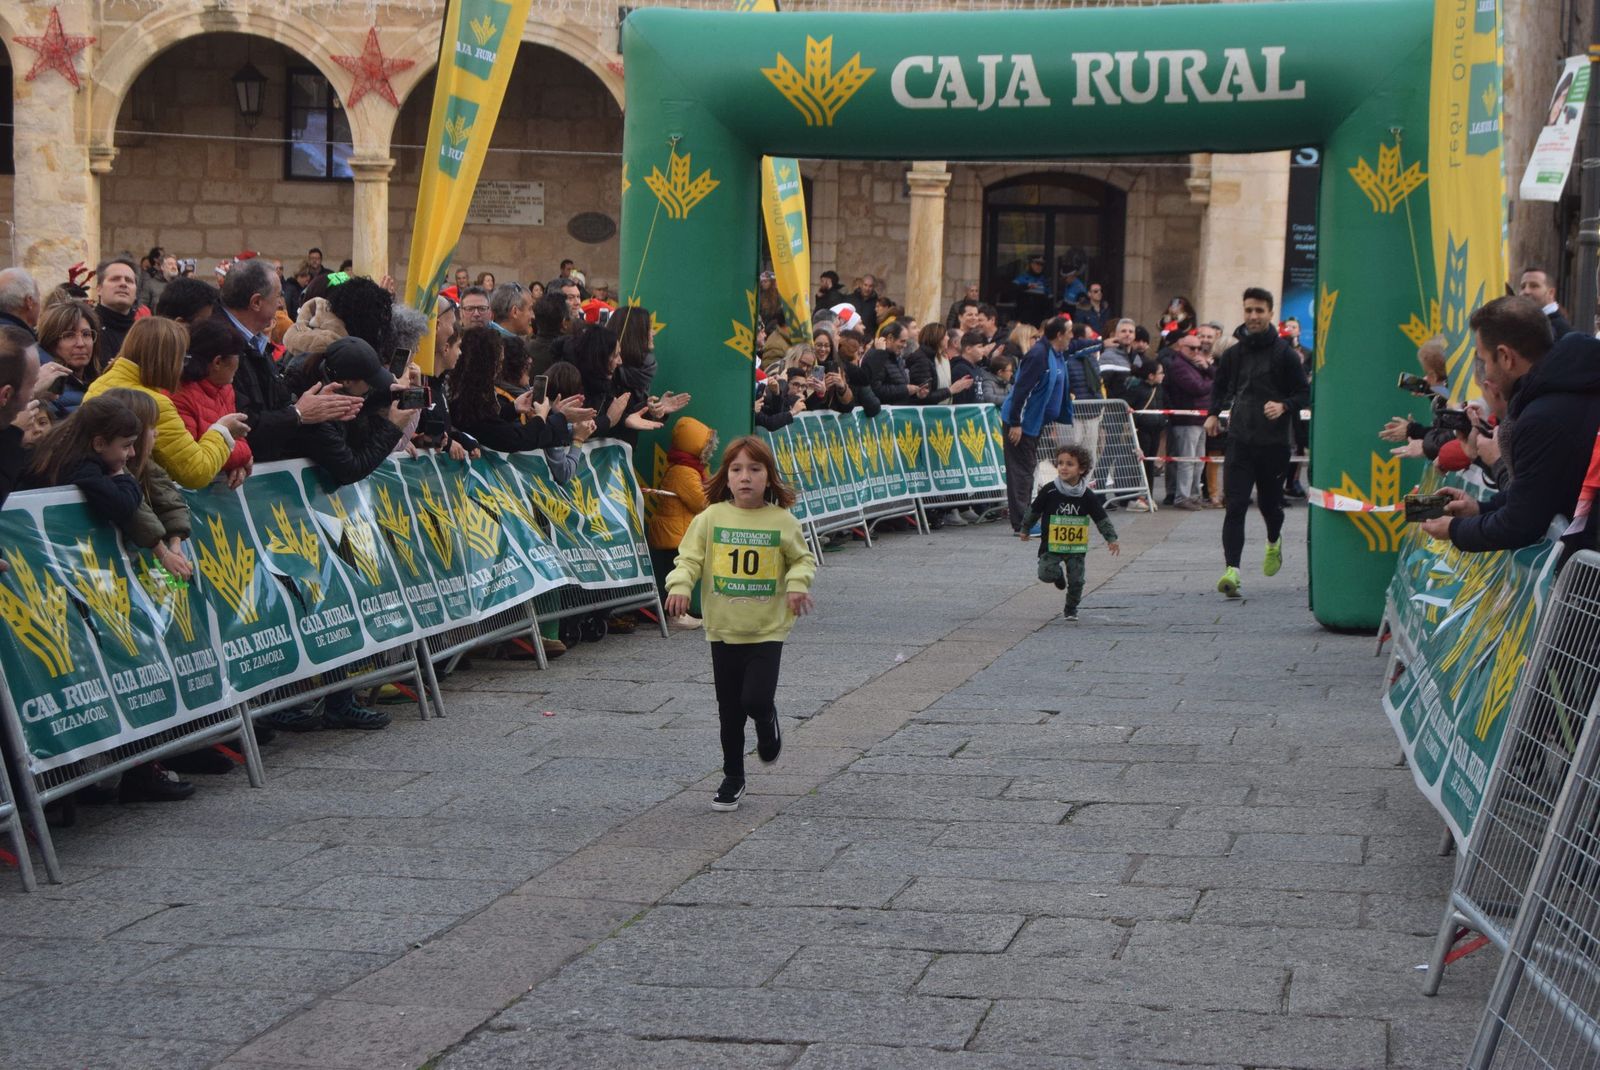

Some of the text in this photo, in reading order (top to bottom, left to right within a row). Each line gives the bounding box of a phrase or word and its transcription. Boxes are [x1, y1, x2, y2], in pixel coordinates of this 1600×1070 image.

[456, 40, 496, 63] AJA RURA
[891, 46, 1305, 111] CAJA RURAL
[1053, 527, 1083, 541] 1364
[728, 548, 759, 575] 10
[727, 582, 772, 591] CAJA RURAL
[300, 603, 356, 636] CAJA RURAL
[222, 623, 293, 661] CAJA RURAL
[315, 627, 352, 648] DE ZAMORA
[174, 653, 193, 677] CAJA
[239, 649, 286, 674] DE ZAMORA
[112, 662, 171, 695] CAJA RURAL
[62, 678, 110, 711] RURAL
[127, 688, 167, 710] DE ZAMORA
